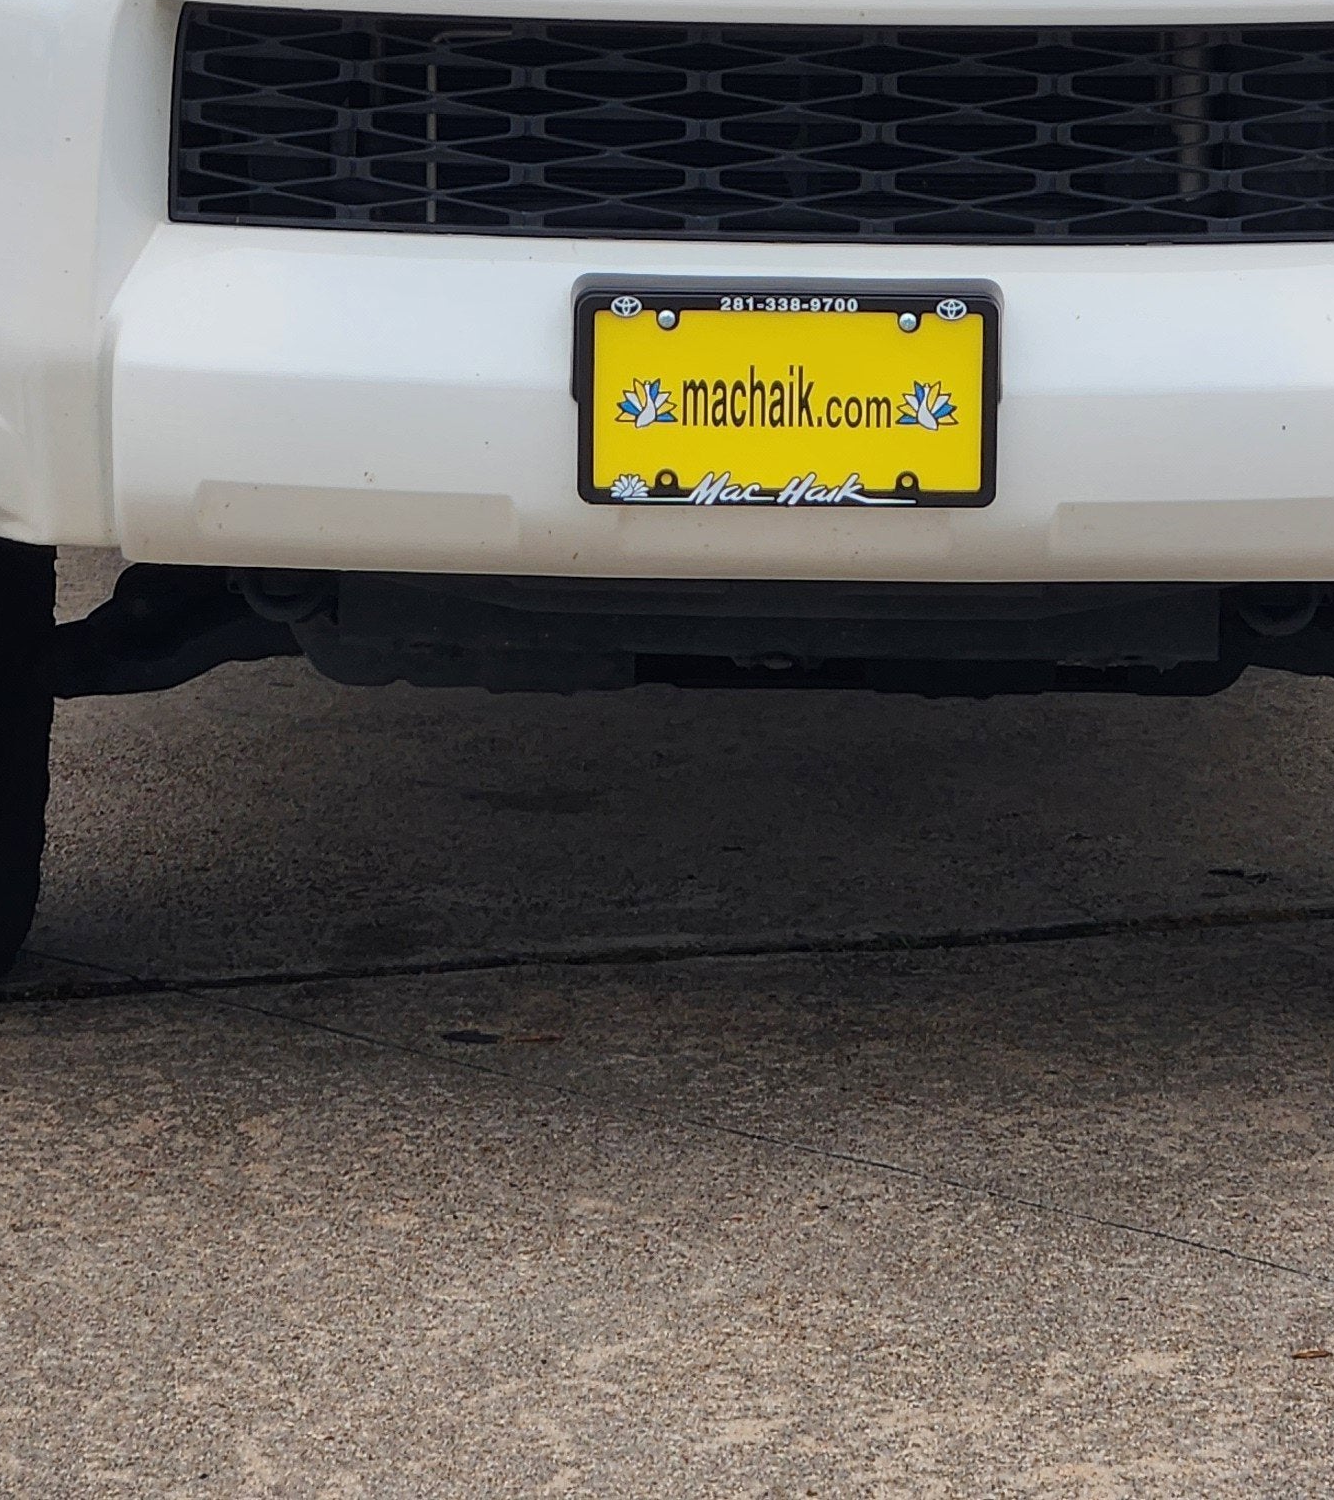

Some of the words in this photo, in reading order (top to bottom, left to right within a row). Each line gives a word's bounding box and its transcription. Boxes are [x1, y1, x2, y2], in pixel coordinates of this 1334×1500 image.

[720, 297, 859, 313] 281-338-9700
[681, 365, 892, 429] machaik.com
[688, 471, 774, 504] Mac
[776, 472, 867, 505] Haik
